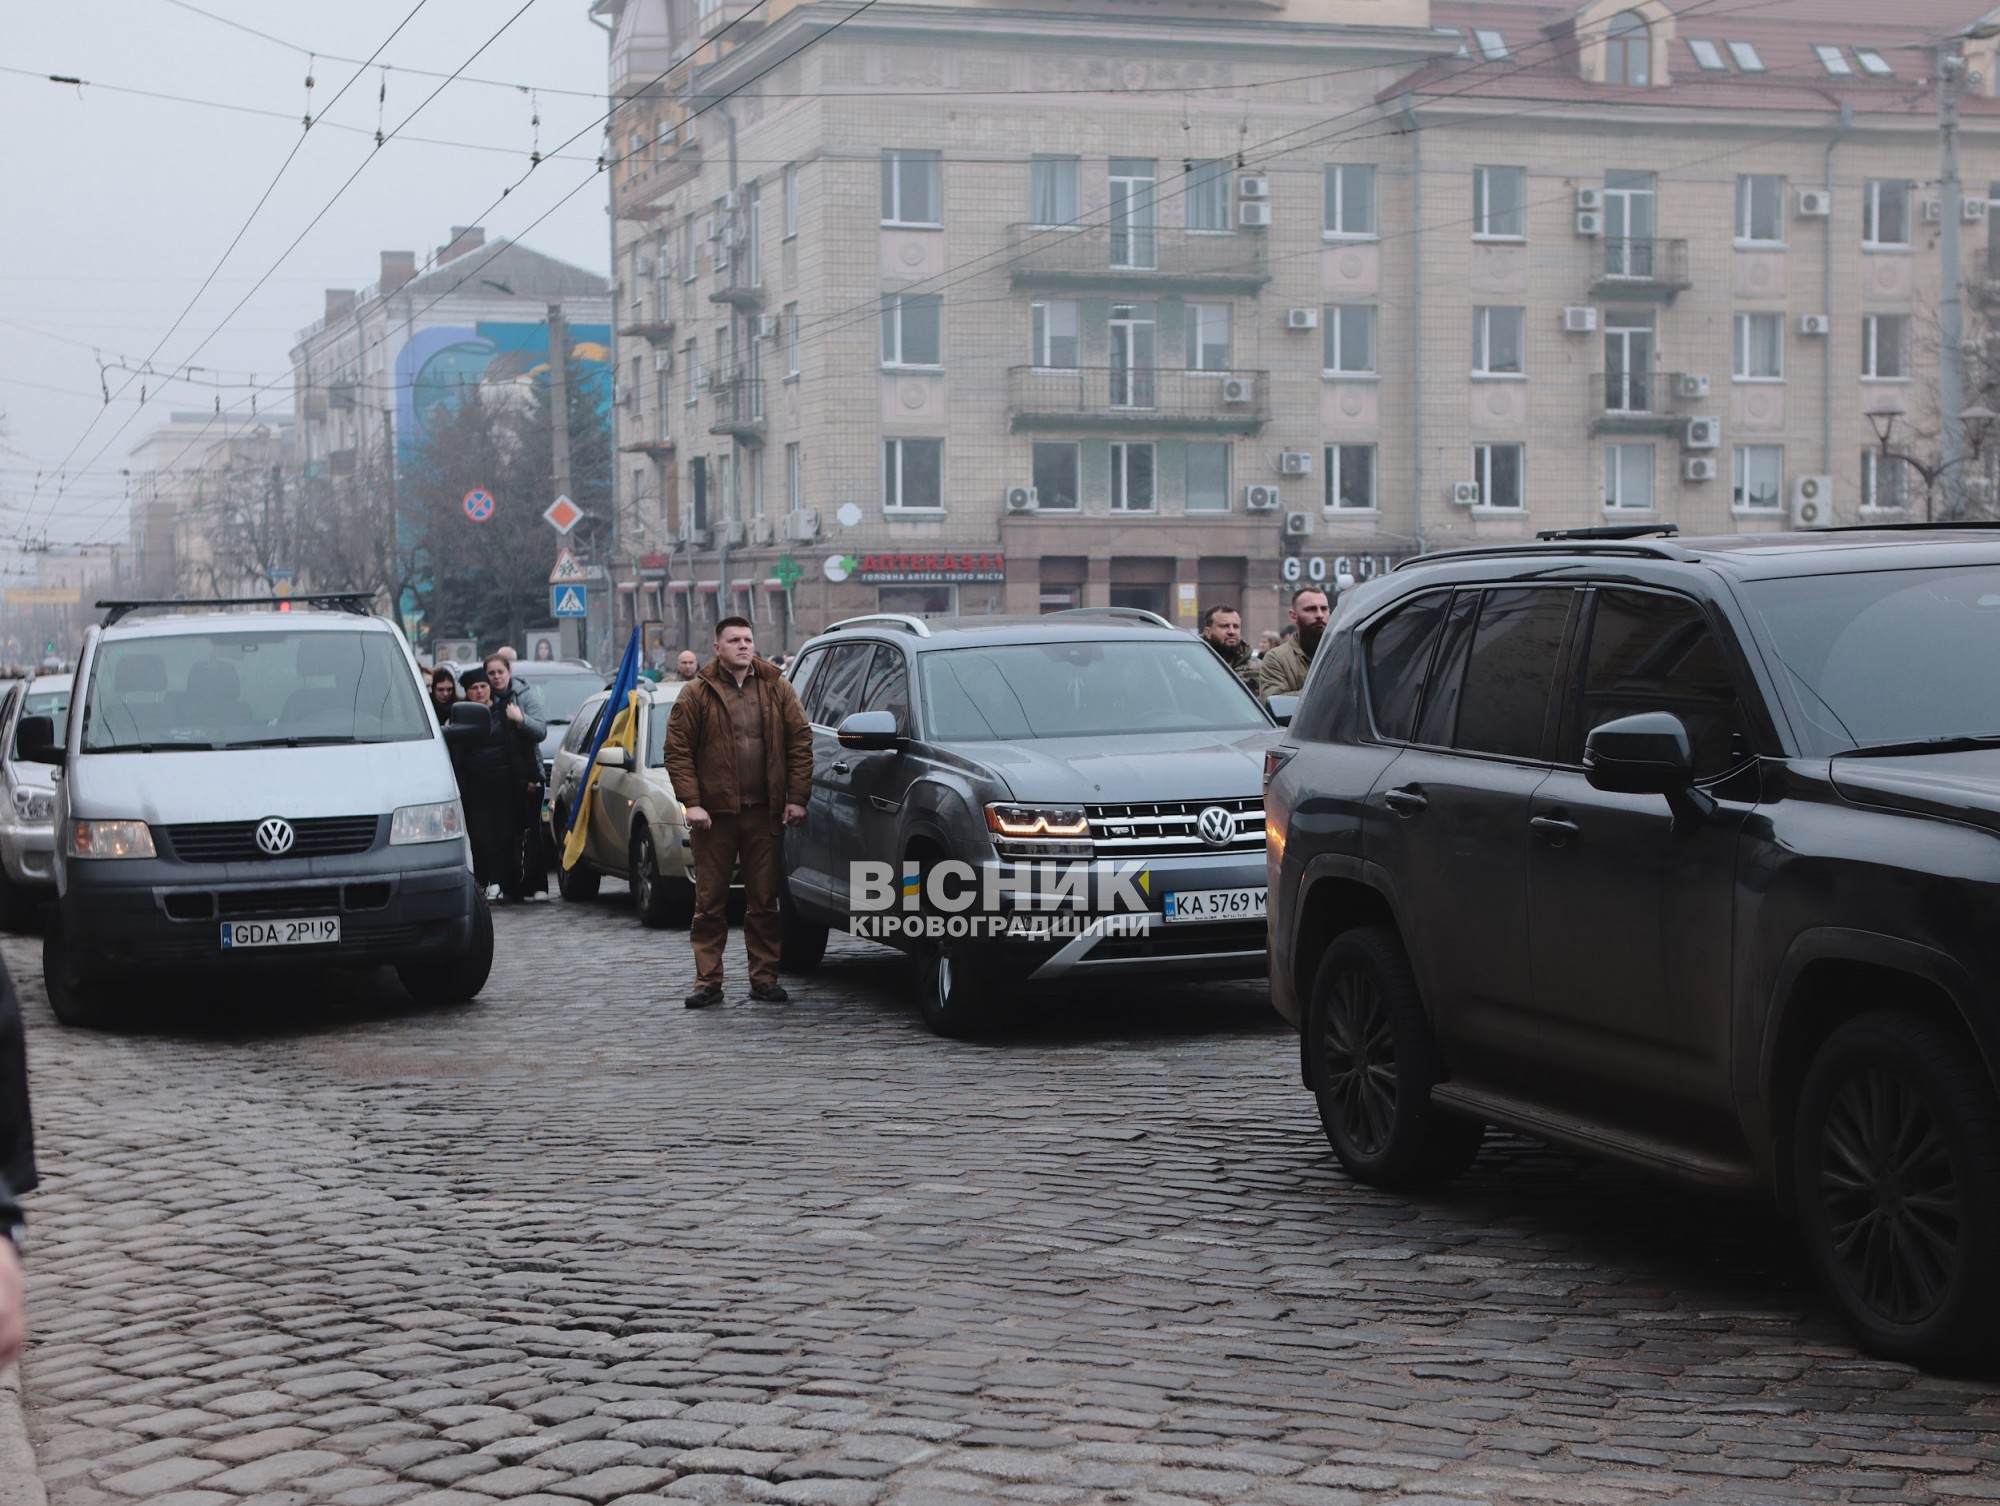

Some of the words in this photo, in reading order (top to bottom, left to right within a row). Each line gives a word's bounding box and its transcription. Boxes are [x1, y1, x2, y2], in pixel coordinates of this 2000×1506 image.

[862, 573, 905, 581] ГОЛОВНА
[907, 573, 942, 581] АПТЕКА
[1176, 896, 1204, 915] KA
[1209, 892, 1250, 913] 5769
[235, 924, 279, 944] GDA
[286, 920, 336, 942] 2PU9
